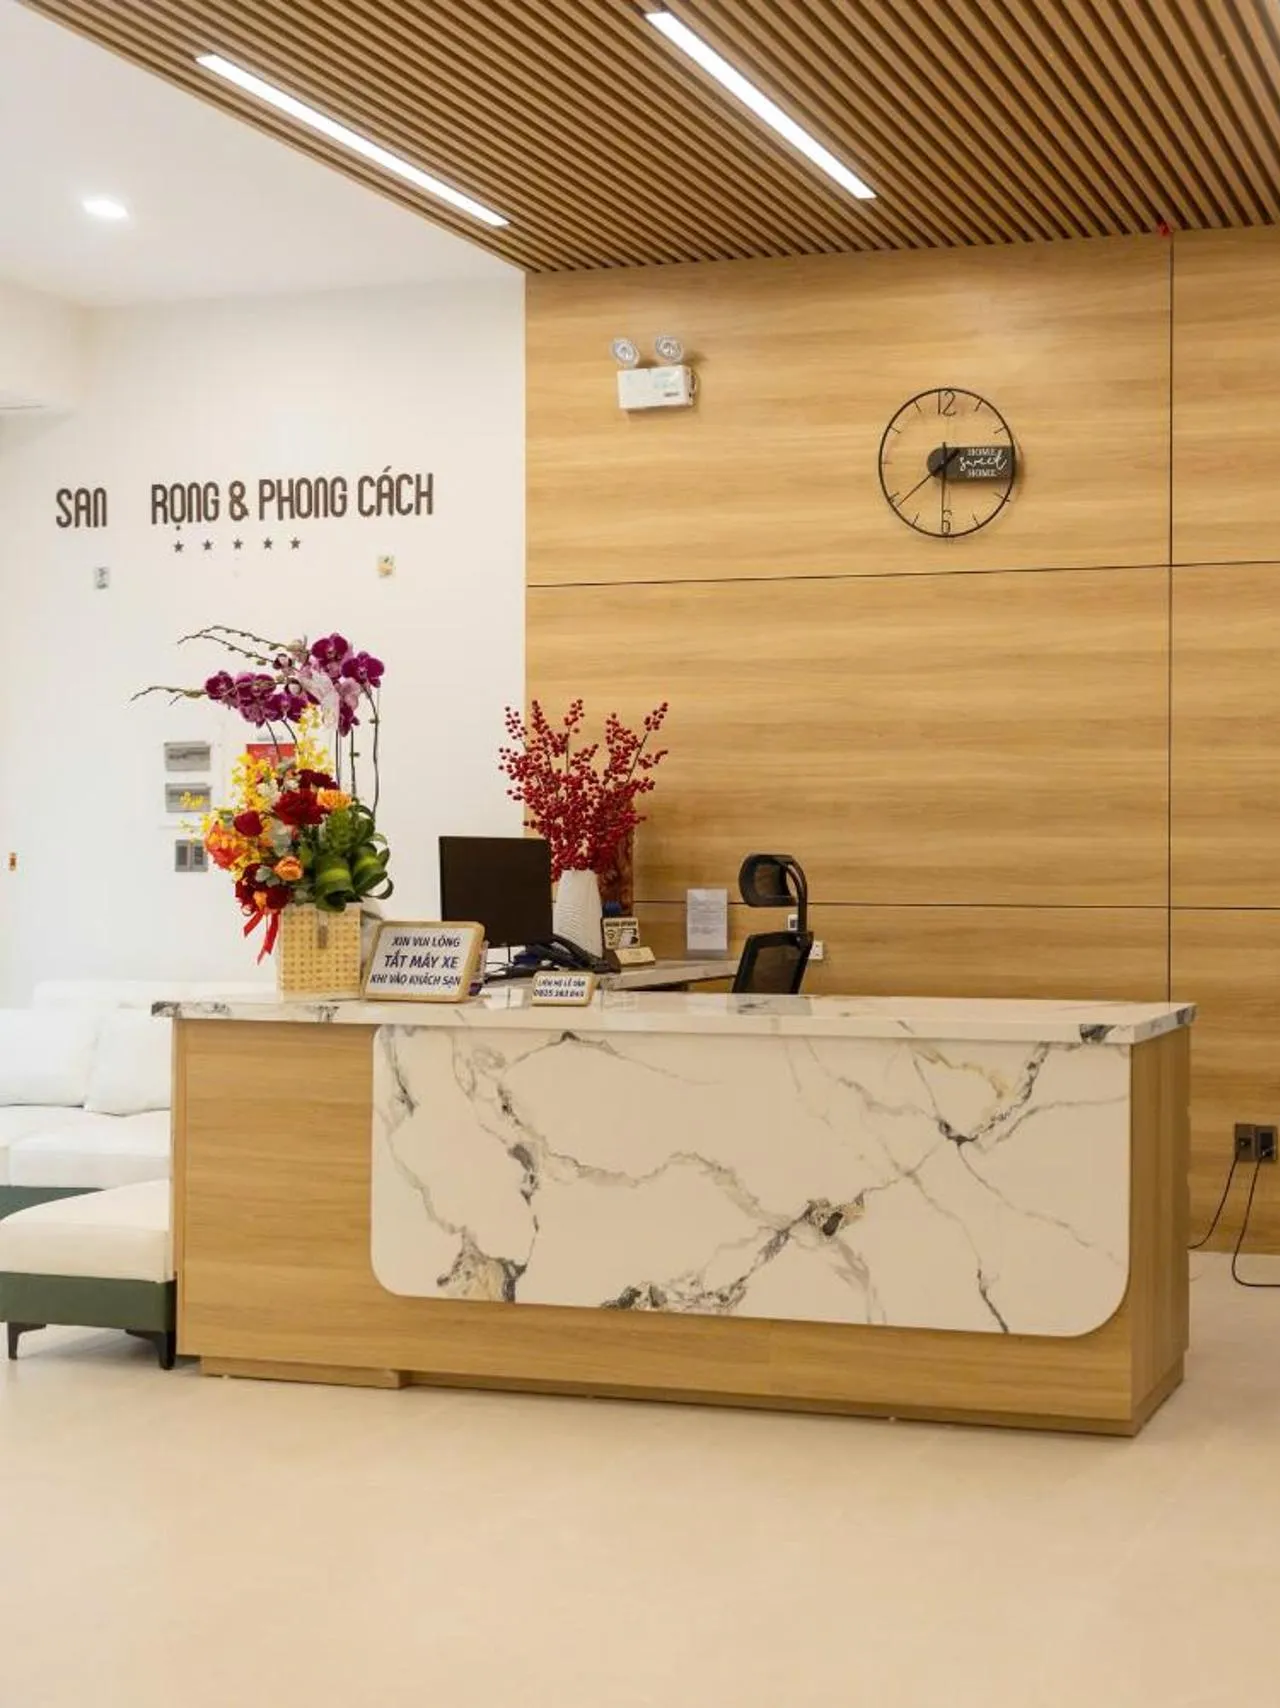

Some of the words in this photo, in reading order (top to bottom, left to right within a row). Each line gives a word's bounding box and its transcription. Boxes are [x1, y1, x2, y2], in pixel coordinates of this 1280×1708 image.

[937, 389, 957, 417] 12
[55, 487, 107, 528] SAN
[151, 481, 220, 531] RỌNG
[228, 480, 249, 522] &
[258, 475, 348, 521] PHONG
[357, 465, 433, 517] CÁCH
[391, 935, 410, 947] XIN
[412, 936, 430, 947] VUI
[431, 935, 460, 948] LÒNG
[384, 947, 408, 969] TẮT
[409, 951, 439, 969] MÁY
[440, 954, 461, 969] XE
[369, 973, 388, 985] KHI
